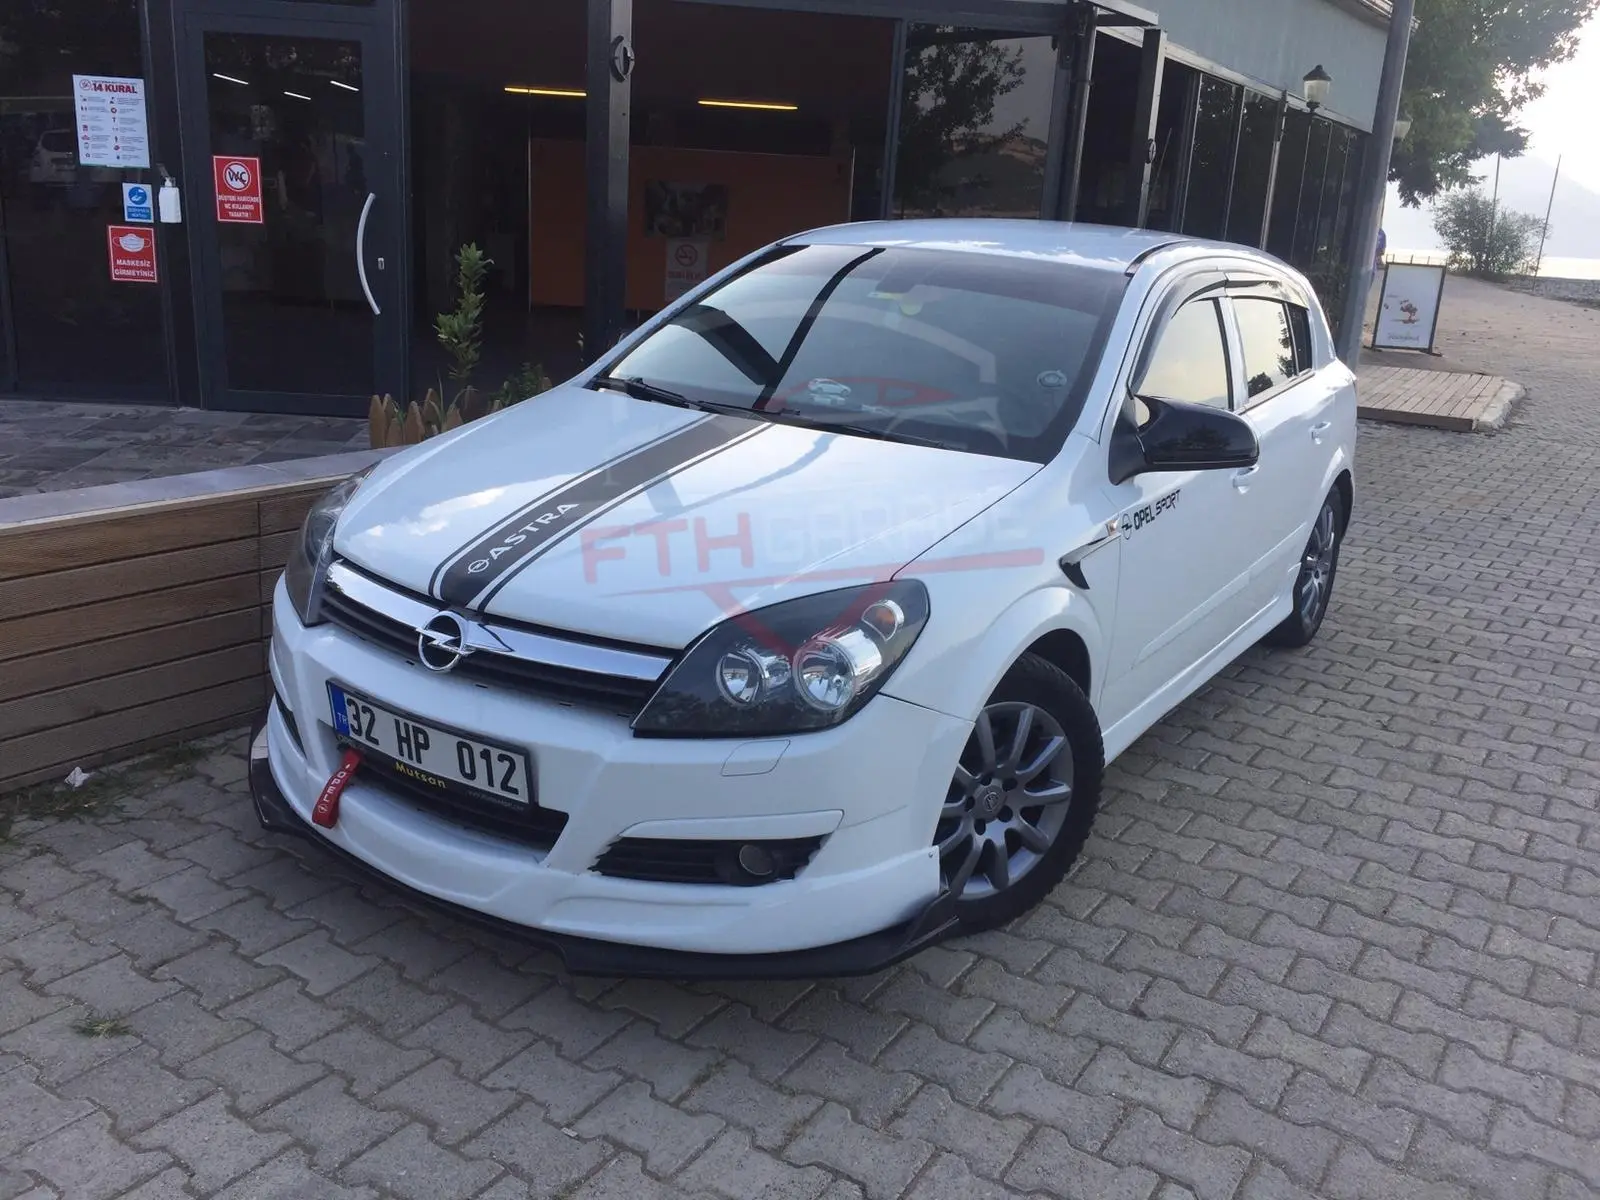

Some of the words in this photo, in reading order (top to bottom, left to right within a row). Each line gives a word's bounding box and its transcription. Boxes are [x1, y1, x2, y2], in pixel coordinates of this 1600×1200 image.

[92, 83, 104, 92] 14
[104, 84, 138, 94] KURAL
[228, 171, 247, 183] WC
[114, 268, 154, 278] GİRMEYİNİZ
[116, 259, 151, 268] MASKESİZ
[1133, 504, 1155, 530] OPEL
[1155, 489, 1180, 516] SPORT
[489, 503, 579, 560] ASTRA
[337, 712, 348, 725] TR
[346, 698, 379, 746] 32
[394, 718, 430, 764] HP
[456, 741, 519, 795] 012
[395, 761, 446, 789] Mutsan
[323, 771, 346, 803] OPEL
